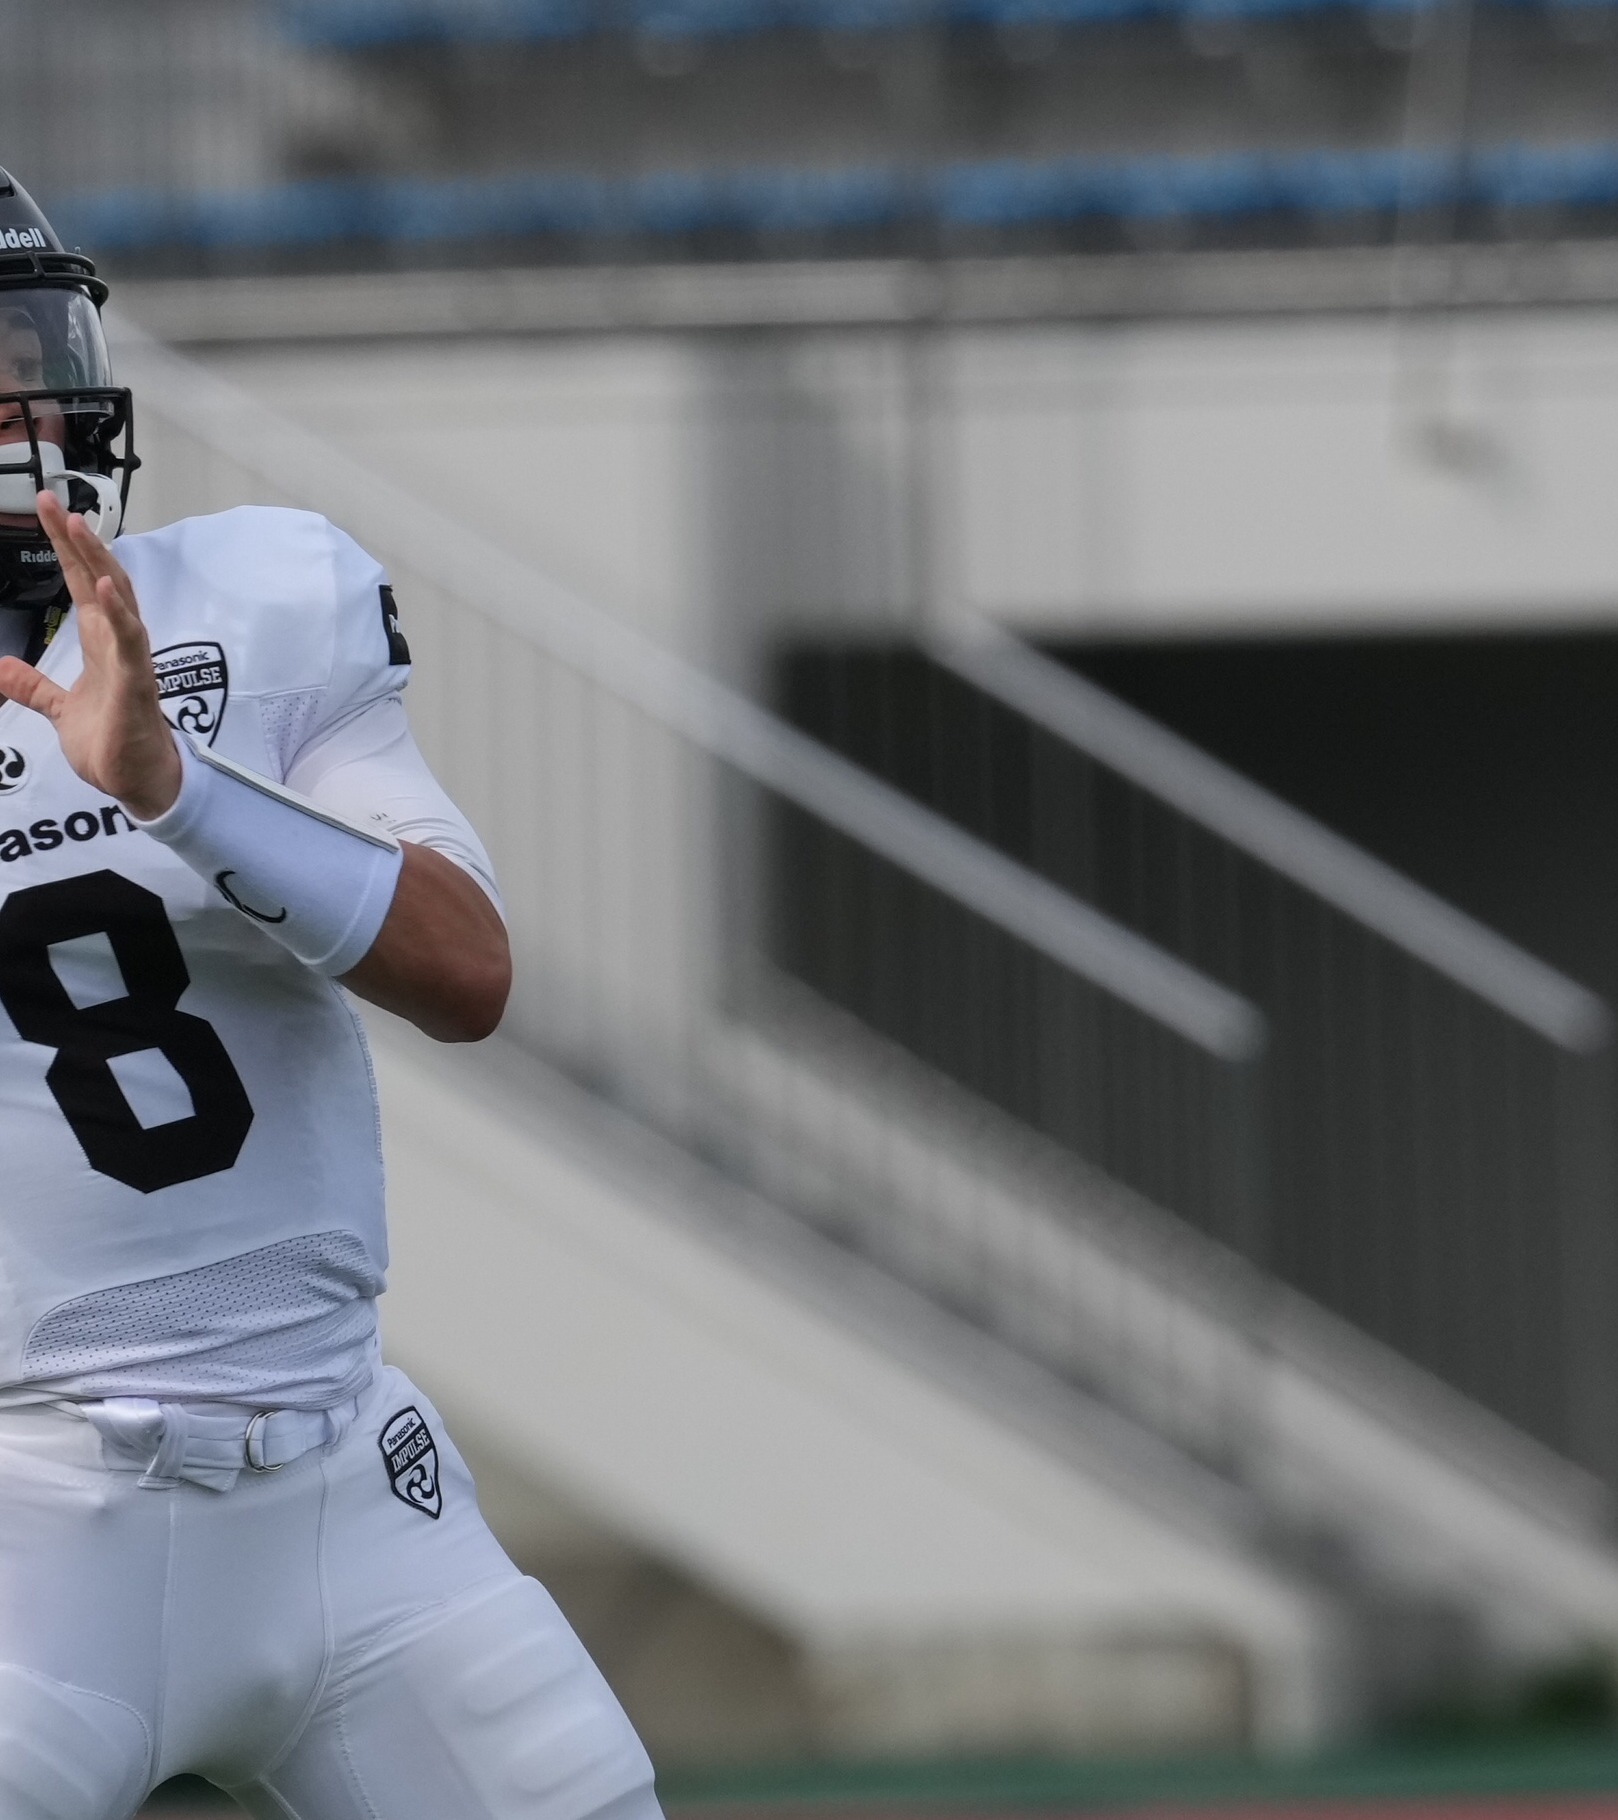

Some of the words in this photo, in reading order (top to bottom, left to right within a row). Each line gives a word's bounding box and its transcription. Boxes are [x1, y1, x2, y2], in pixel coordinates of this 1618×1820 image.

[20, 550, 58, 563] Ridde
[152, 650, 210, 671] Panasonic
[155, 666, 222, 694] MPULSE
[387, 1417, 416, 1449] Panasonic
[391, 1428, 430, 1473] IMPULSE
